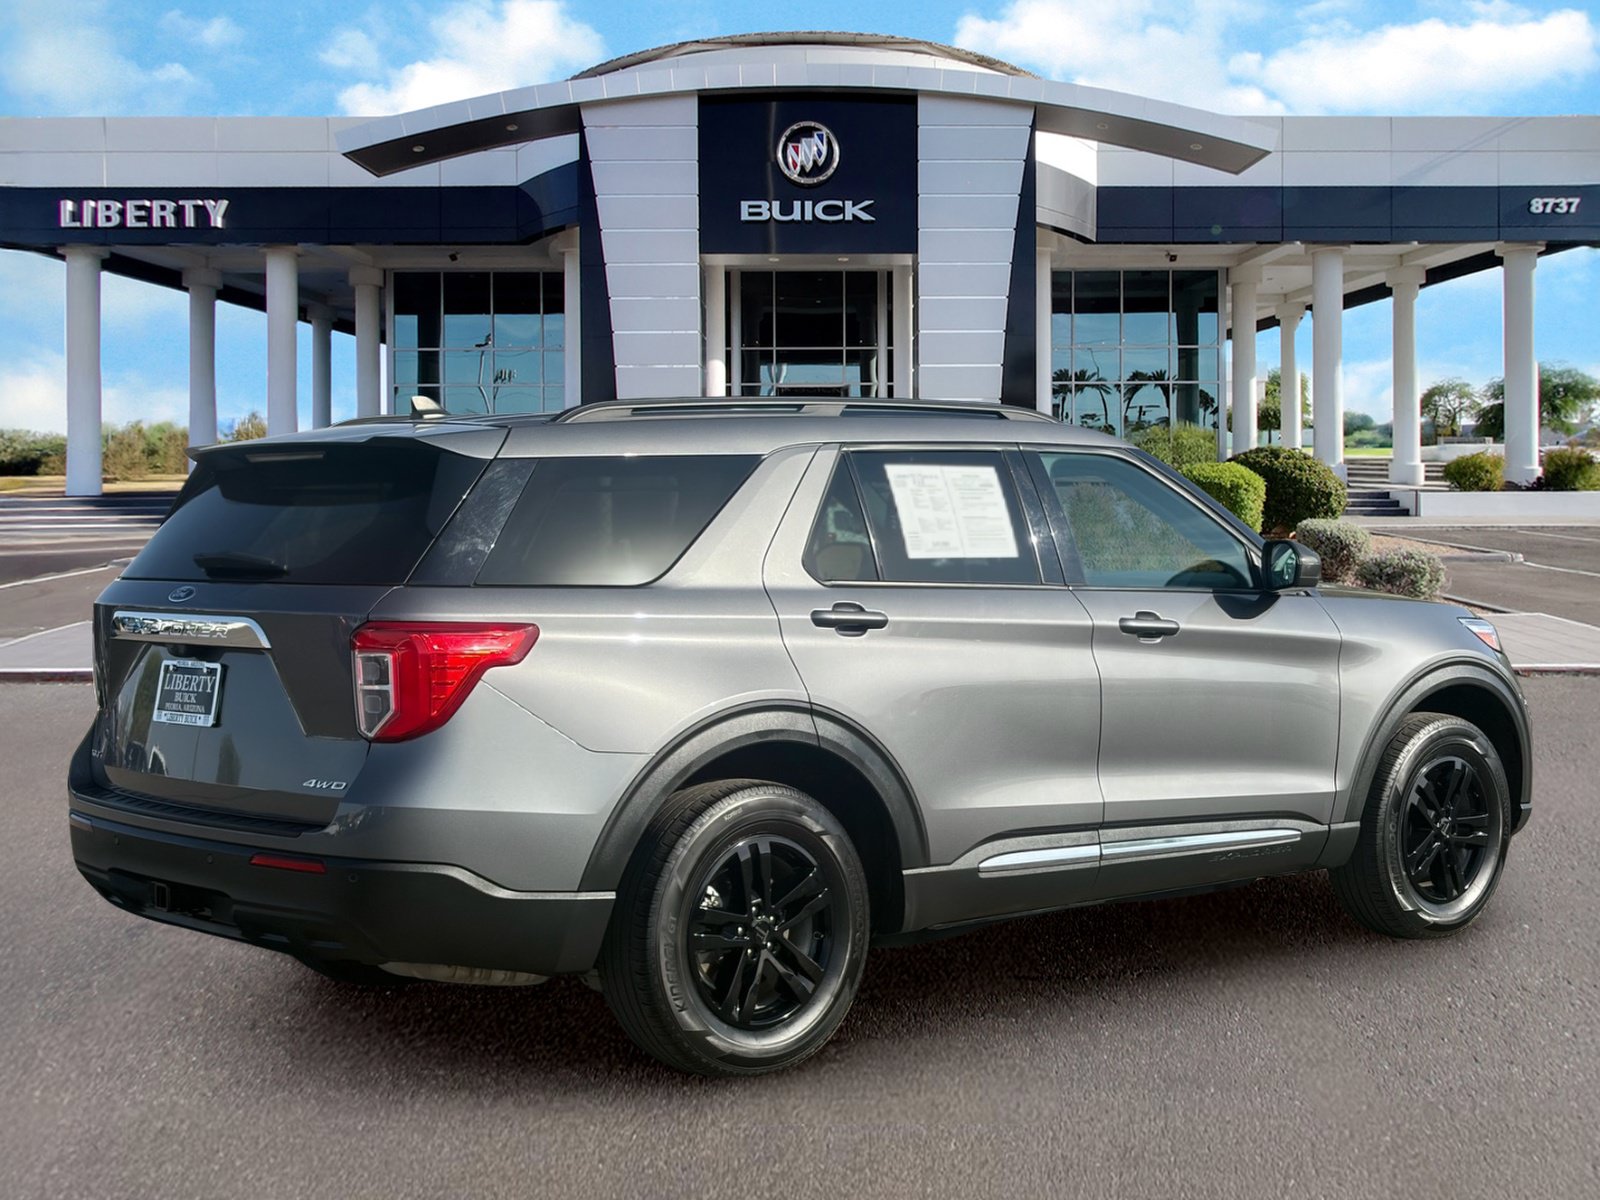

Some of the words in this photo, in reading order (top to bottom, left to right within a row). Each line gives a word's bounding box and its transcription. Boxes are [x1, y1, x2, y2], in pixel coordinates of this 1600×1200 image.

[59, 199, 229, 228] LIBERTY
[740, 200, 876, 221] BUICK
[1529, 197, 1581, 214] 8737
[164, 673, 216, 693] LIBERTY
[174, 691, 198, 703] BUICK
[303, 779, 347, 789] 4WD
